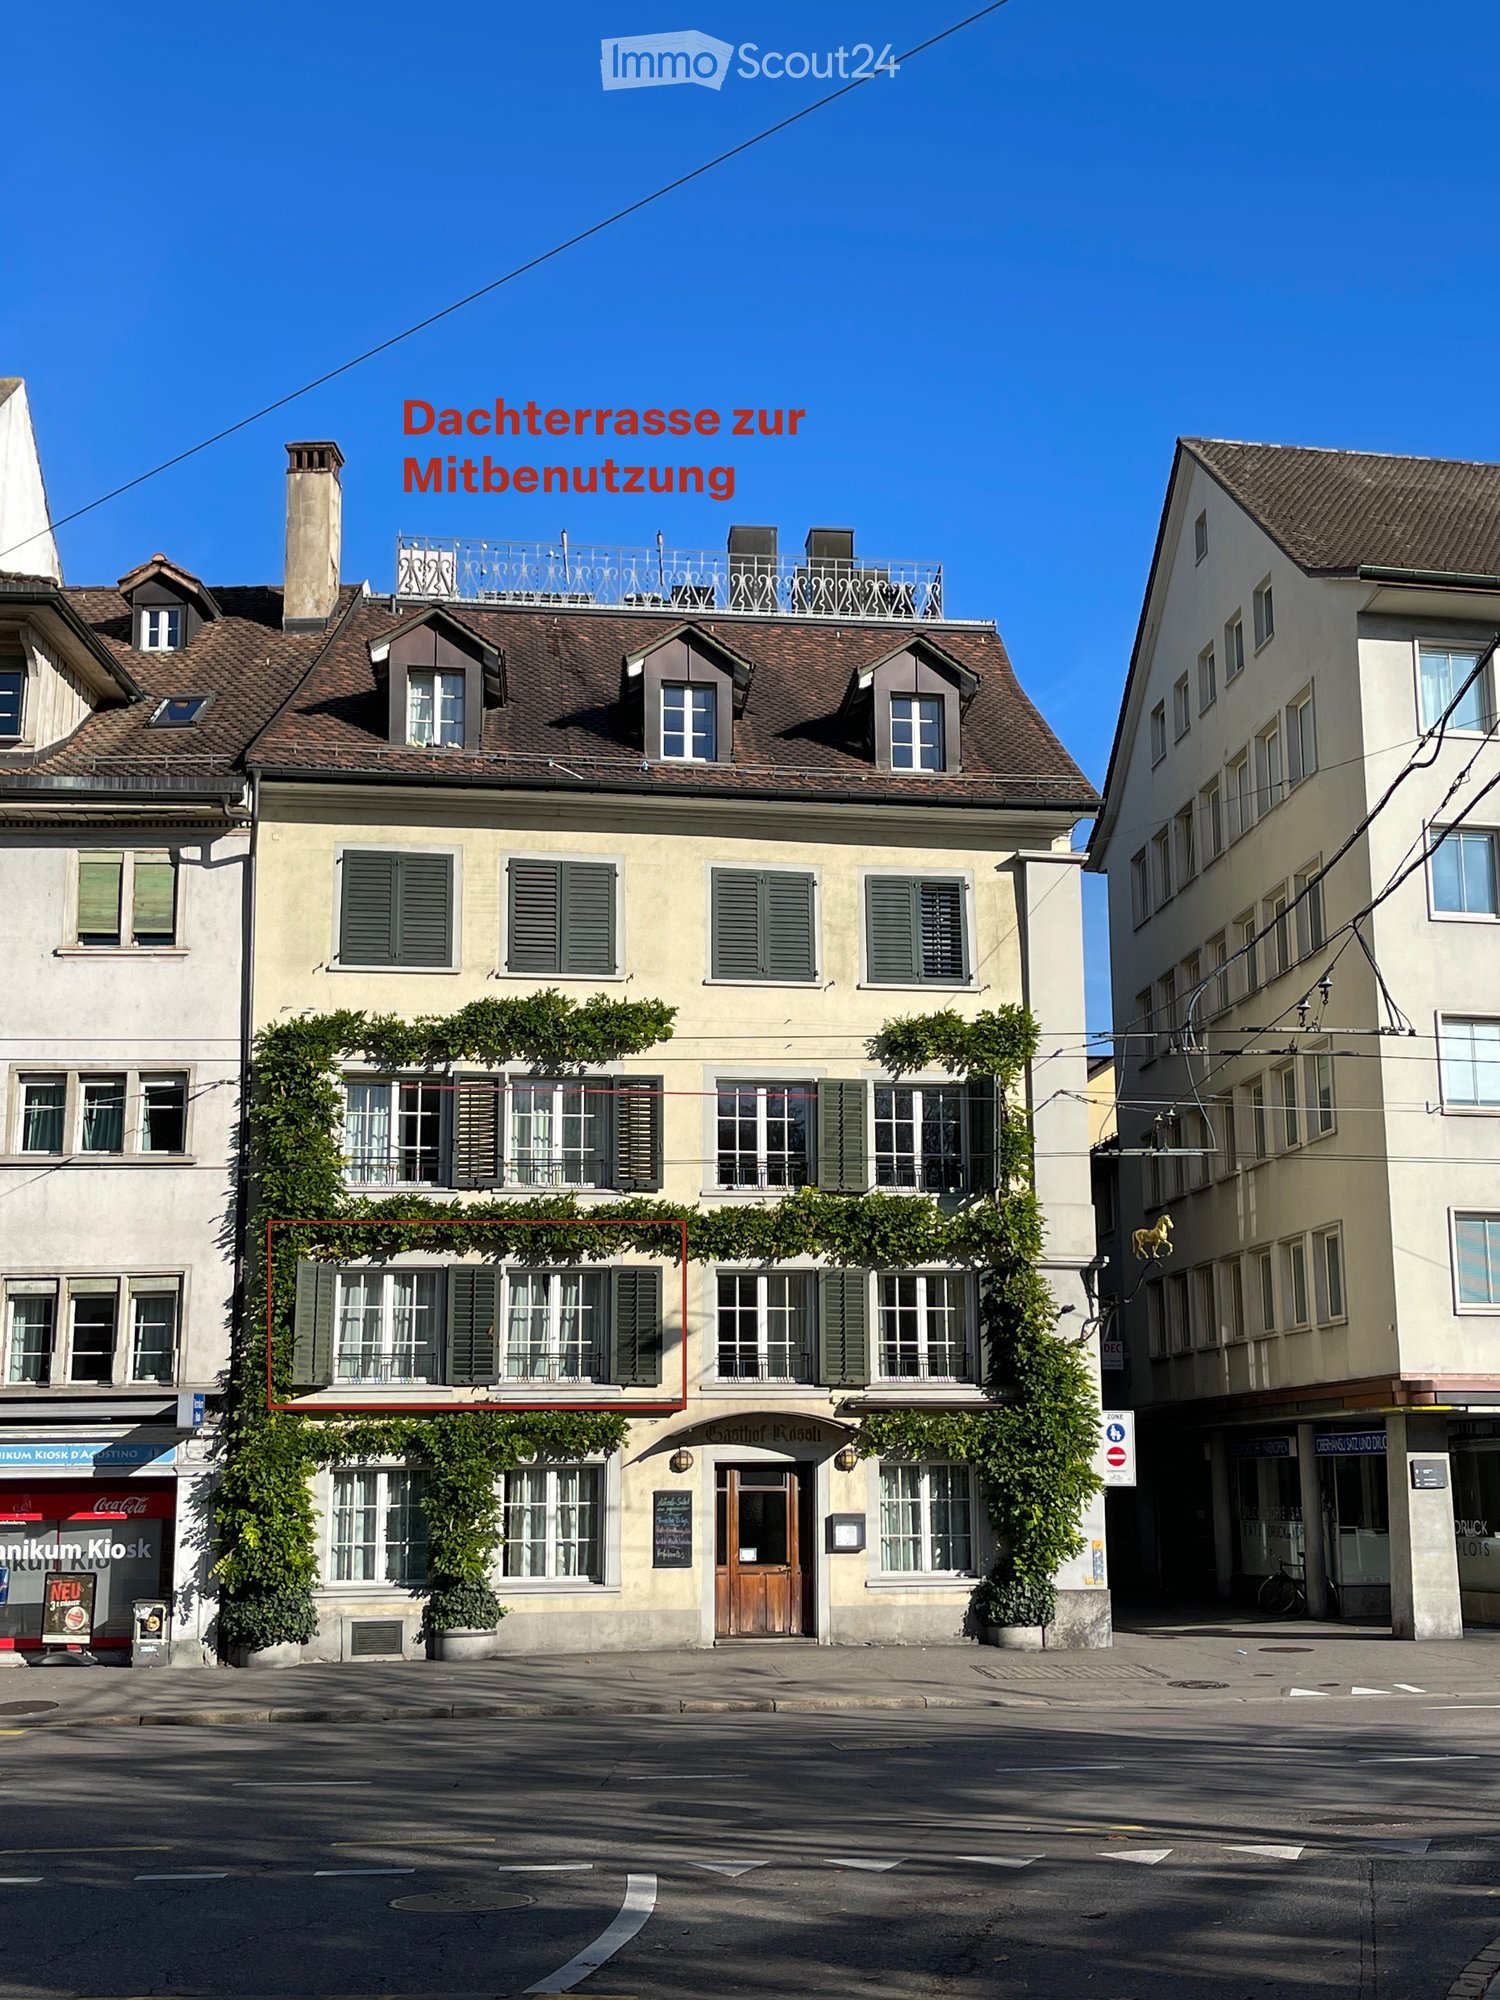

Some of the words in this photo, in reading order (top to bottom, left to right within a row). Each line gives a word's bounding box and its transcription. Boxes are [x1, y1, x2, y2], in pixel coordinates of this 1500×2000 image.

[705, 1425, 766, 1443] Gasthof
[1358, 1436, 1371, 1450] UND
[1372, 1435, 1387, 1449] DRUC
[35, 1450, 68, 1459] KIOSK
[94, 1497, 149, 1514] Coca-Cola
[1454, 1520, 1488, 1535] DRUCK
[88, 1538, 151, 1559] Kiosk
[51, 1582, 80, 1600] NEU
